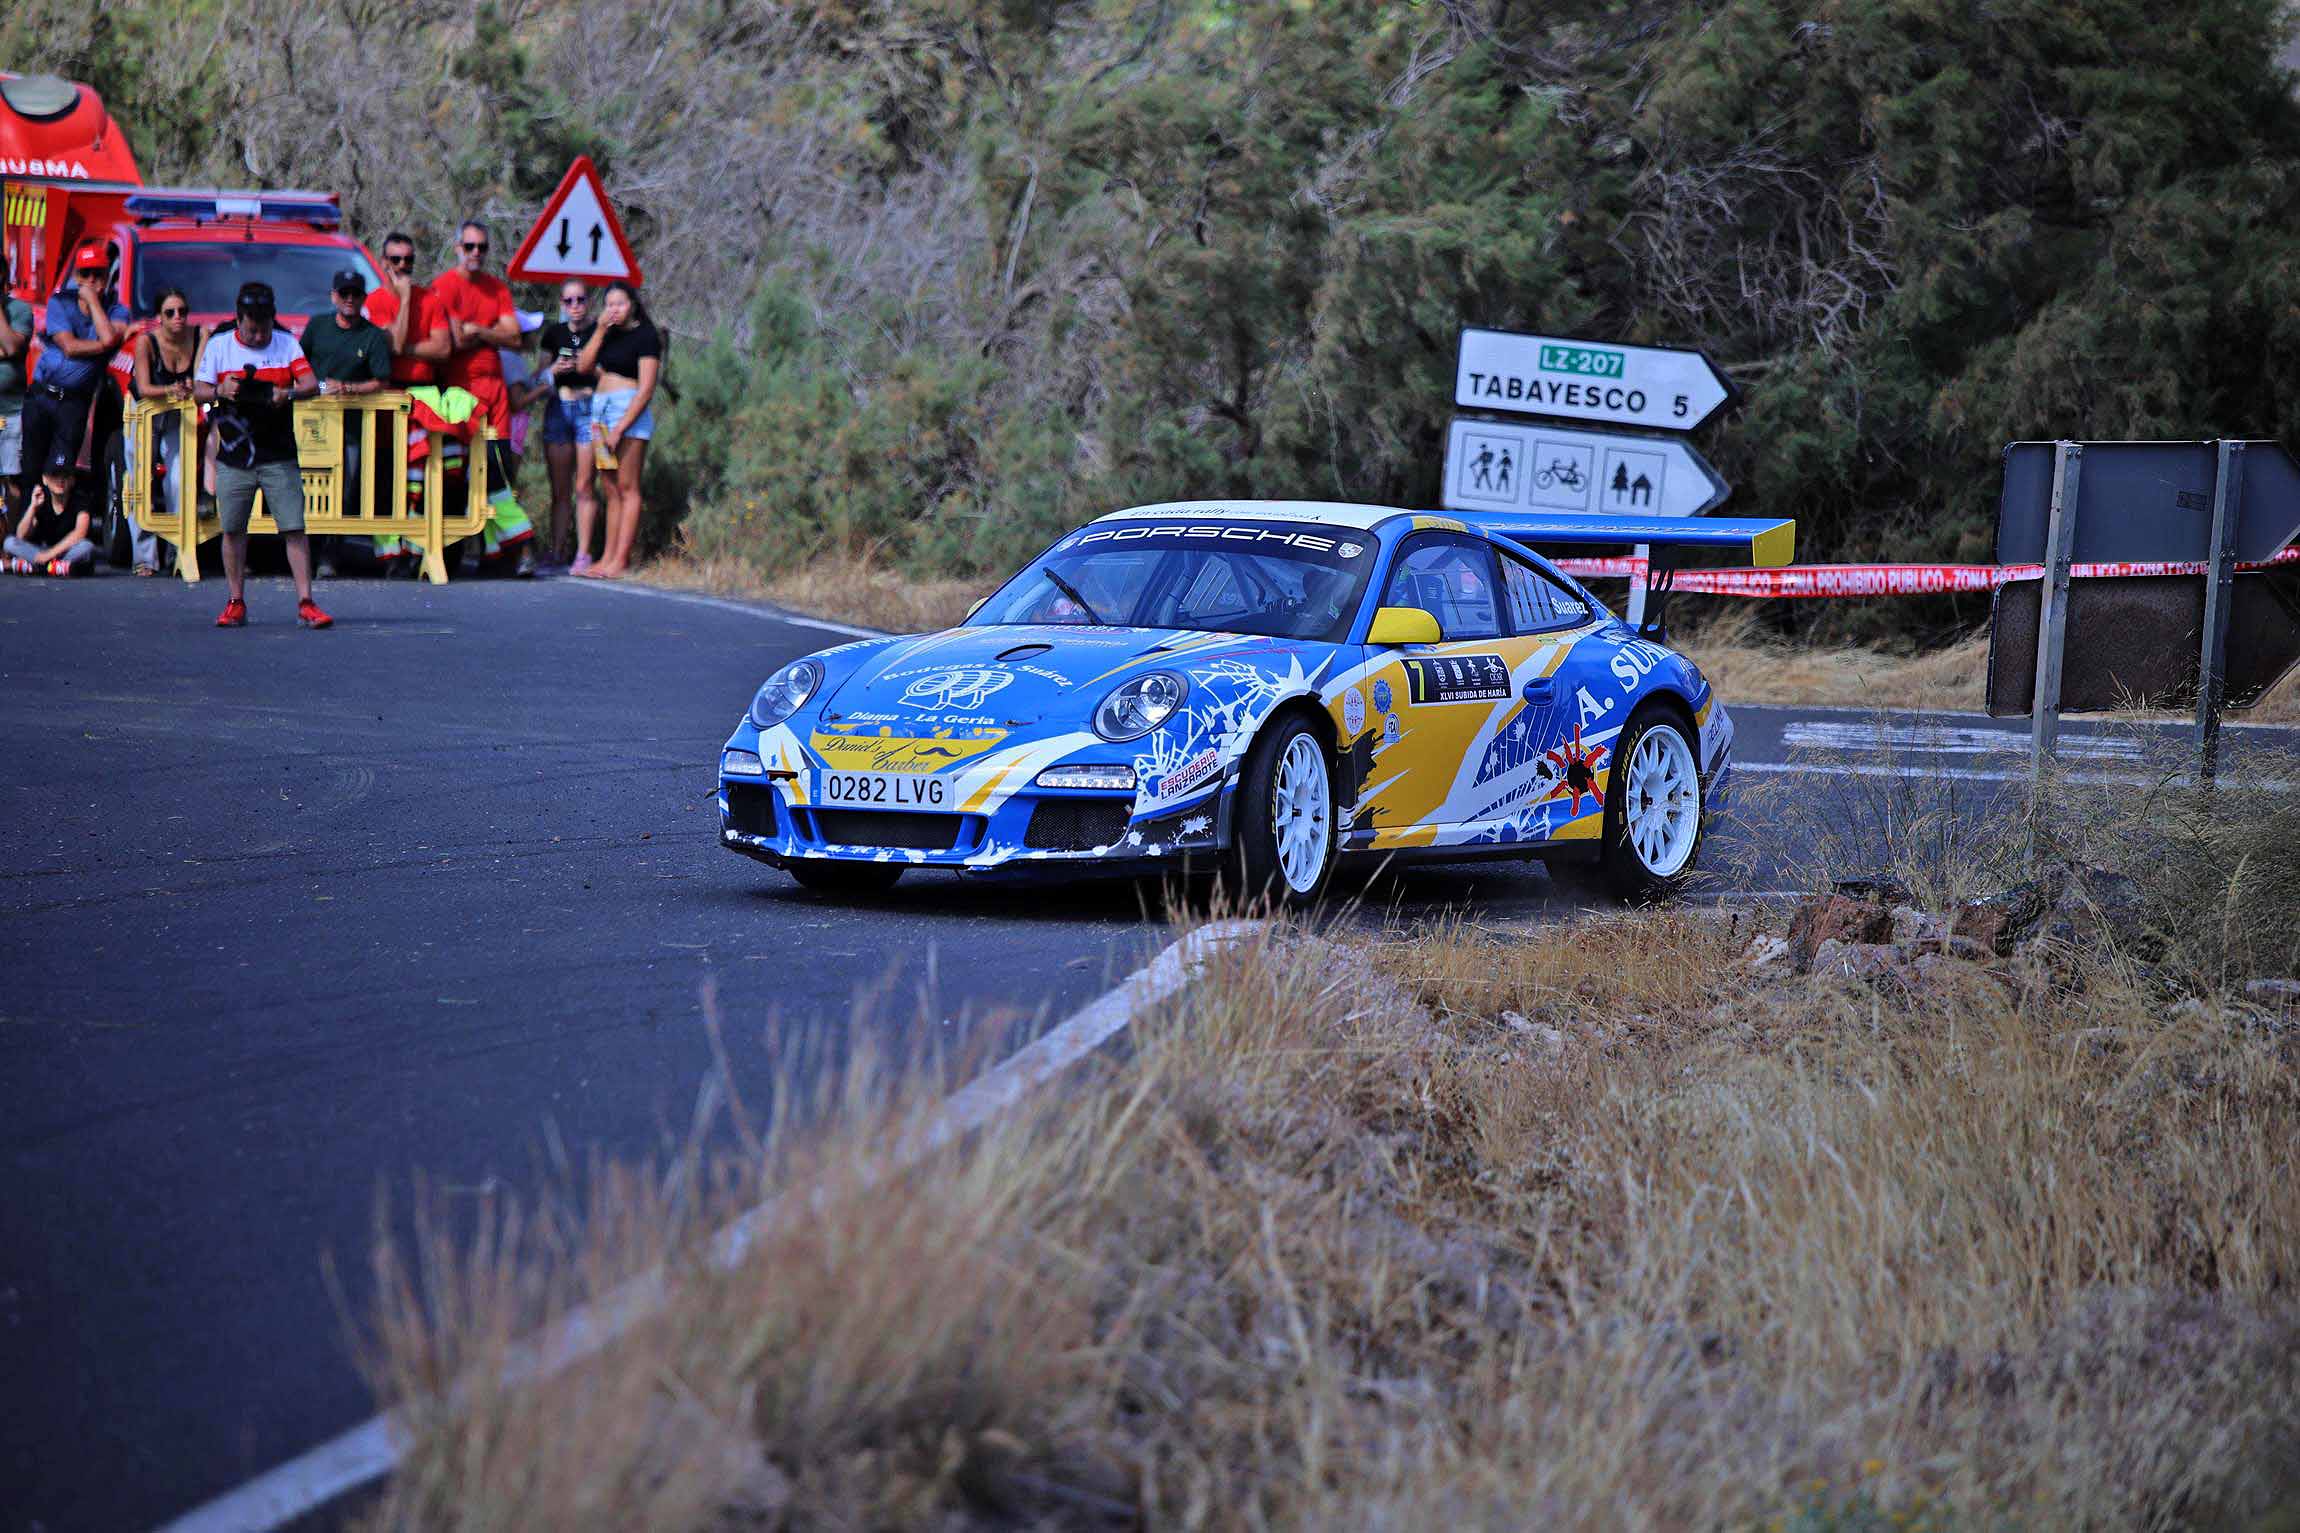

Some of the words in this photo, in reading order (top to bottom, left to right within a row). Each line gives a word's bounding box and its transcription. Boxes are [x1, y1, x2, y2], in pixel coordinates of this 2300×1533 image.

[1541, 348, 1623, 375] LZ-207
[1469, 373, 1647, 413] TABAYESCO
[1673, 395, 1688, 417] 5
[1078, 525, 1336, 552] PORSCHE
[1817, 570, 1887, 595] PROHIBIDO
[1888, 569, 1944, 593] PUBLICO
[1953, 568, 1989, 591] ZONA
[1550, 597, 1589, 616] Suarez
[883, 663, 986, 681] Bodegas
[988, 662, 1009, 670] A.
[1408, 660, 1425, 701] 7
[1440, 691, 1455, 701] XLVI
[1455, 689, 1478, 700] SUBIDA
[1478, 689, 1487, 699] DE
[915, 713, 938, 722] La
[943, 715, 995, 725] Geria
[1576, 686, 1615, 732] A.
[821, 736, 883, 753] Daniel's
[1160, 750, 1217, 791] ESCUDERIA
[1160, 758, 1219, 801] LANZAROTE
[829, 775, 887, 802] 0282
[895, 778, 944, 805] LVG
